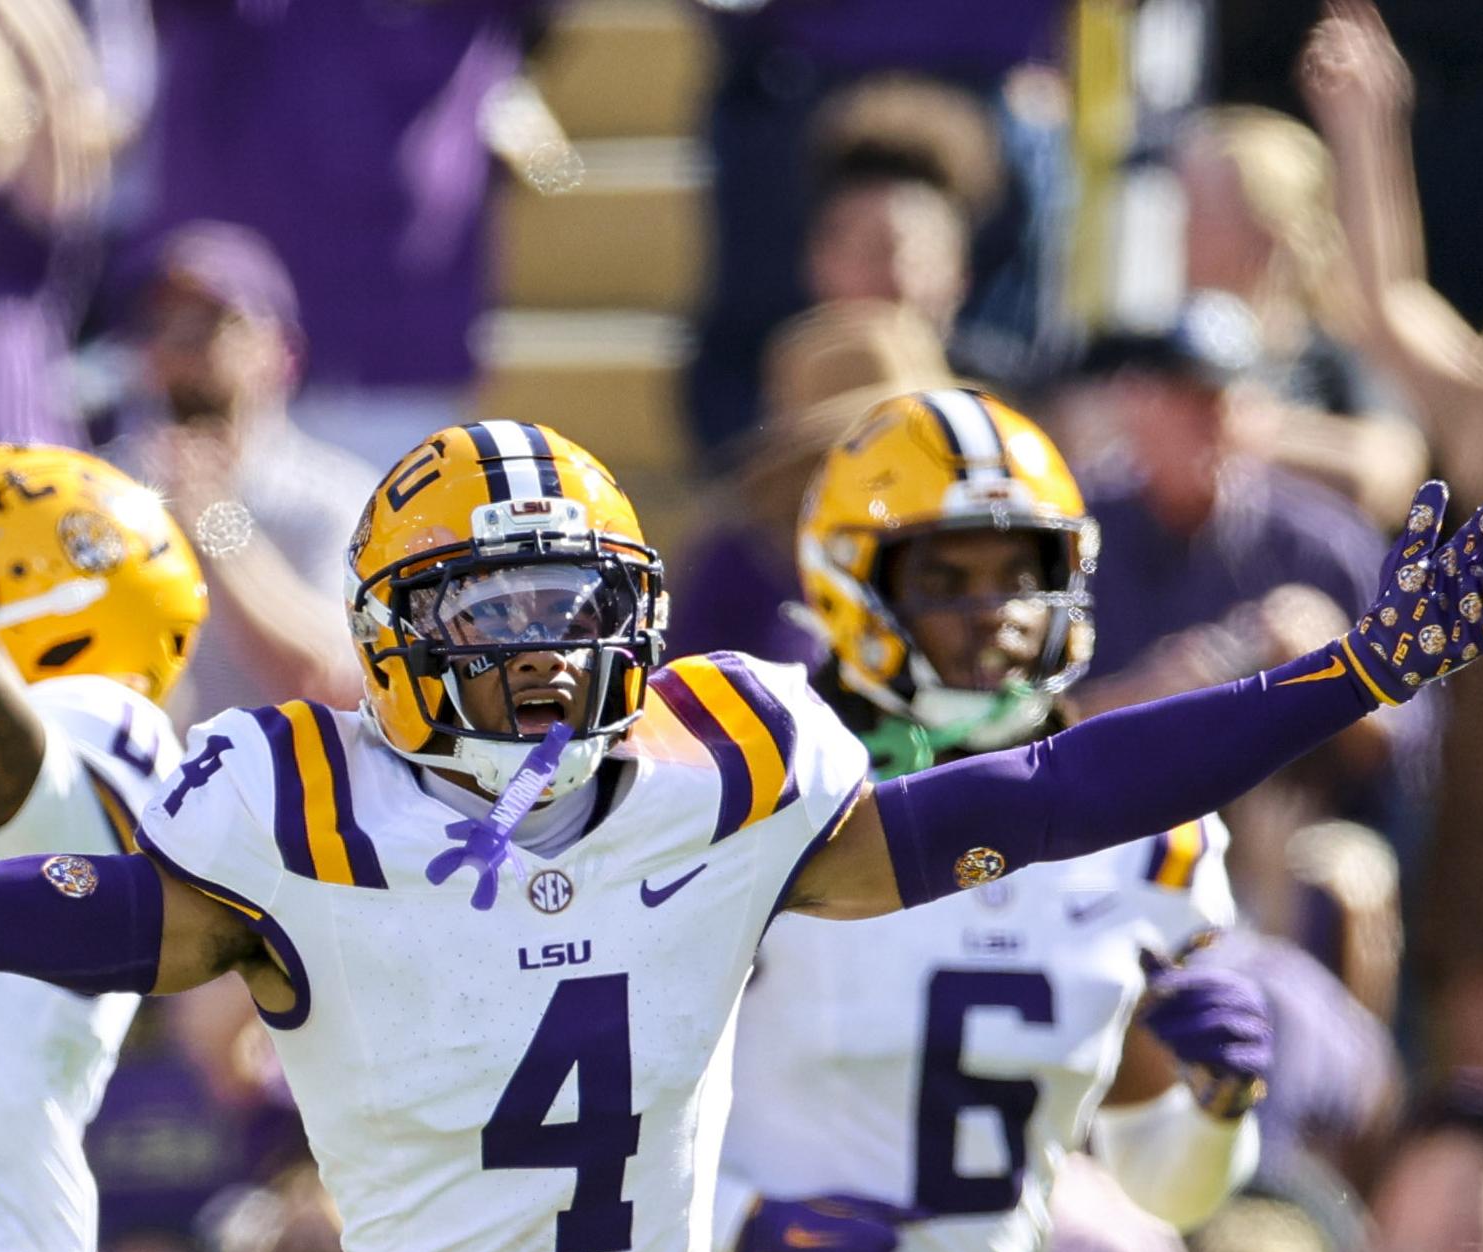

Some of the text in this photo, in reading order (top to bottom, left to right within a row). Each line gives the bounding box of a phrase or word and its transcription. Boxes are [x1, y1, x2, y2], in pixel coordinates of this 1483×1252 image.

[509, 501, 551, 516] LSU
[469, 655, 494, 677] ALL
[1393, 632, 1413, 666] LSU
[163, 735, 234, 818] 4
[490, 768, 545, 828] NXTRND
[531, 872, 571, 912] SEC
[518, 940, 591, 970] LSU
[916, 969, 1054, 1218] 6
